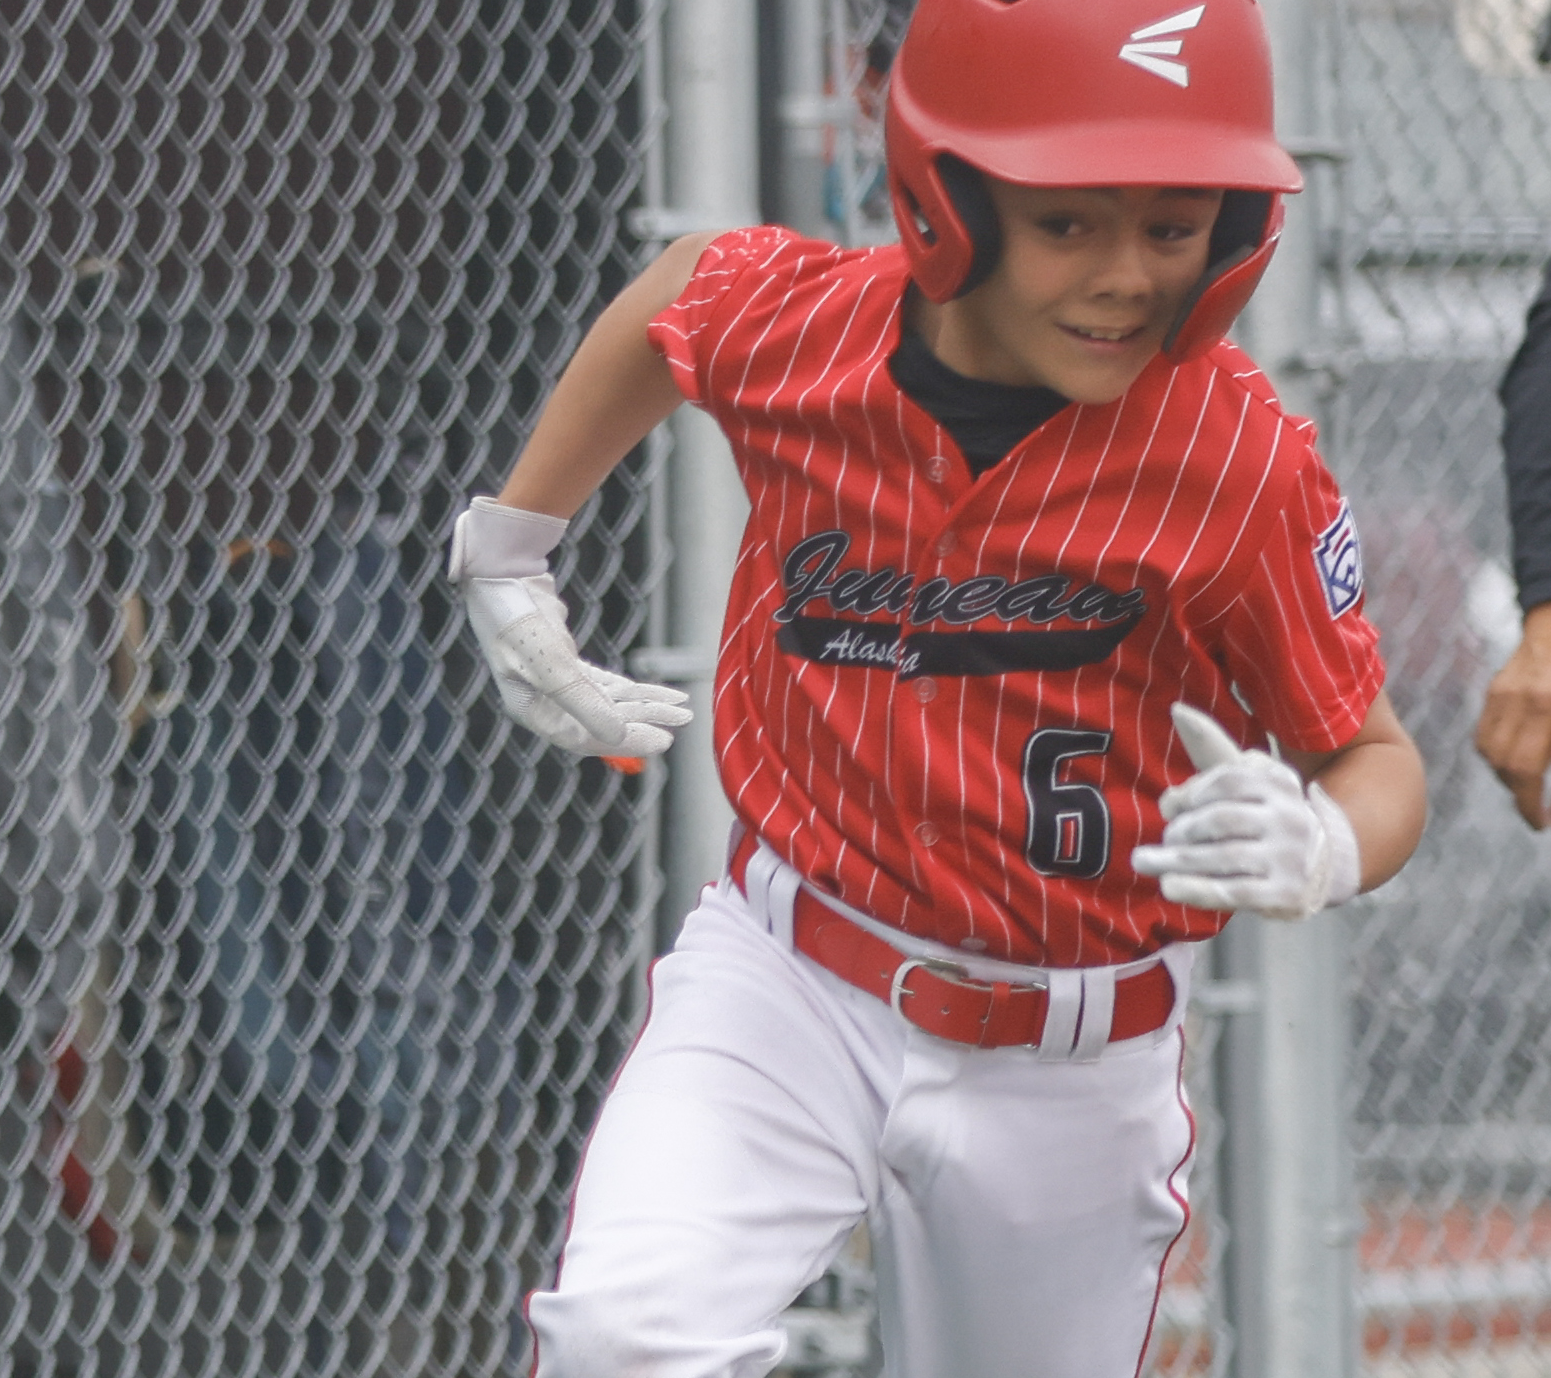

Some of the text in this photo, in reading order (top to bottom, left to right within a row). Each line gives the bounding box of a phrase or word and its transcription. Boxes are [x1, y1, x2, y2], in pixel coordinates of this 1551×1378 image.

[772, 529, 1147, 626] Juneau
[819, 628, 922, 674] Alaska
[1022, 728, 1112, 879] 6
